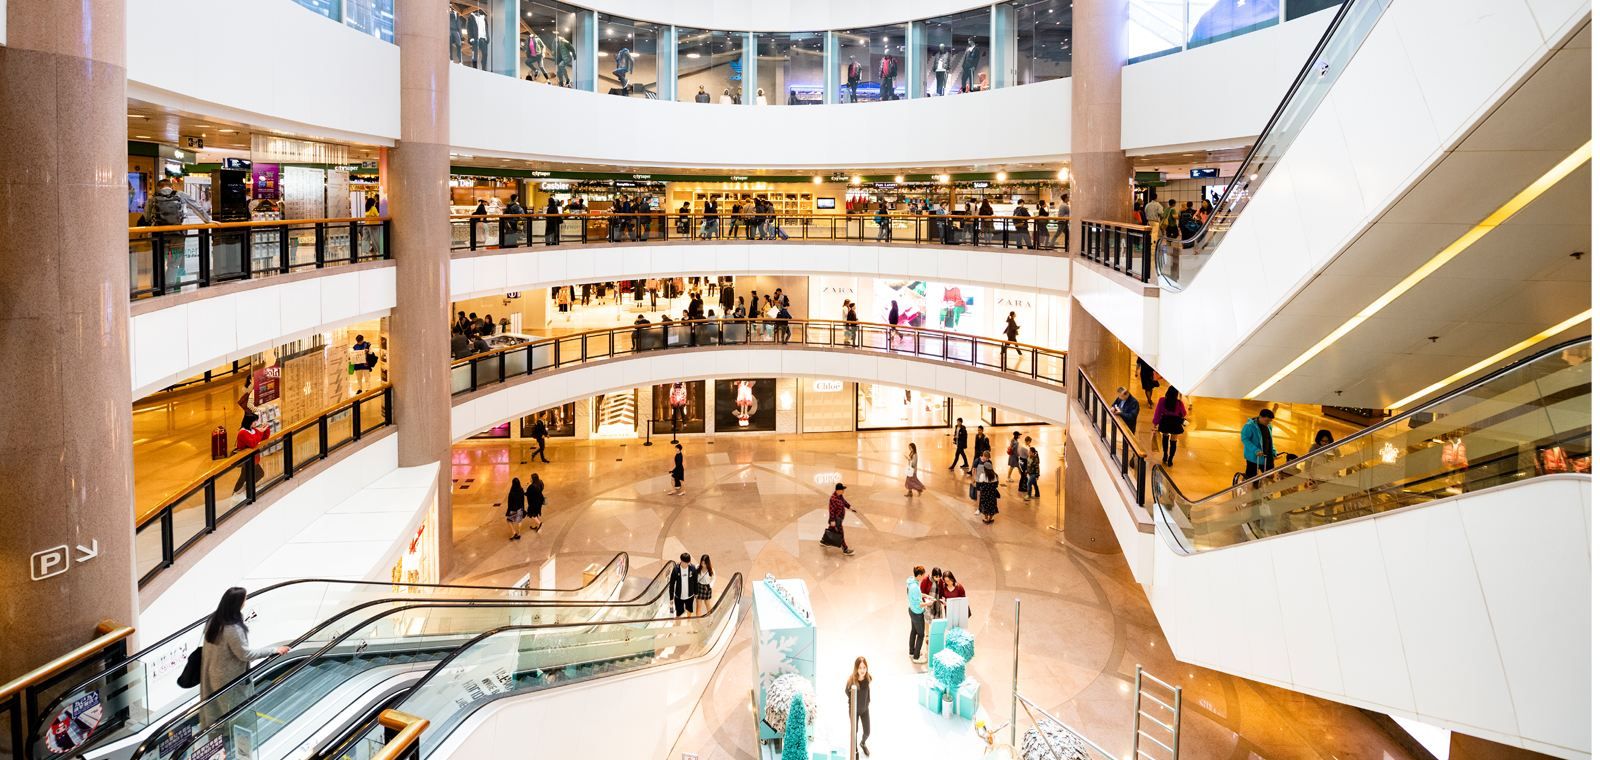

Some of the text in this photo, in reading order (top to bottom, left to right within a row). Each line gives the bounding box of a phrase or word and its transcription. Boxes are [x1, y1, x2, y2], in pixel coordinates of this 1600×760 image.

[541, 181, 570, 190] Cashier
[997, 298, 1031, 308] ZARA
[40, 552, 61, 575] P
